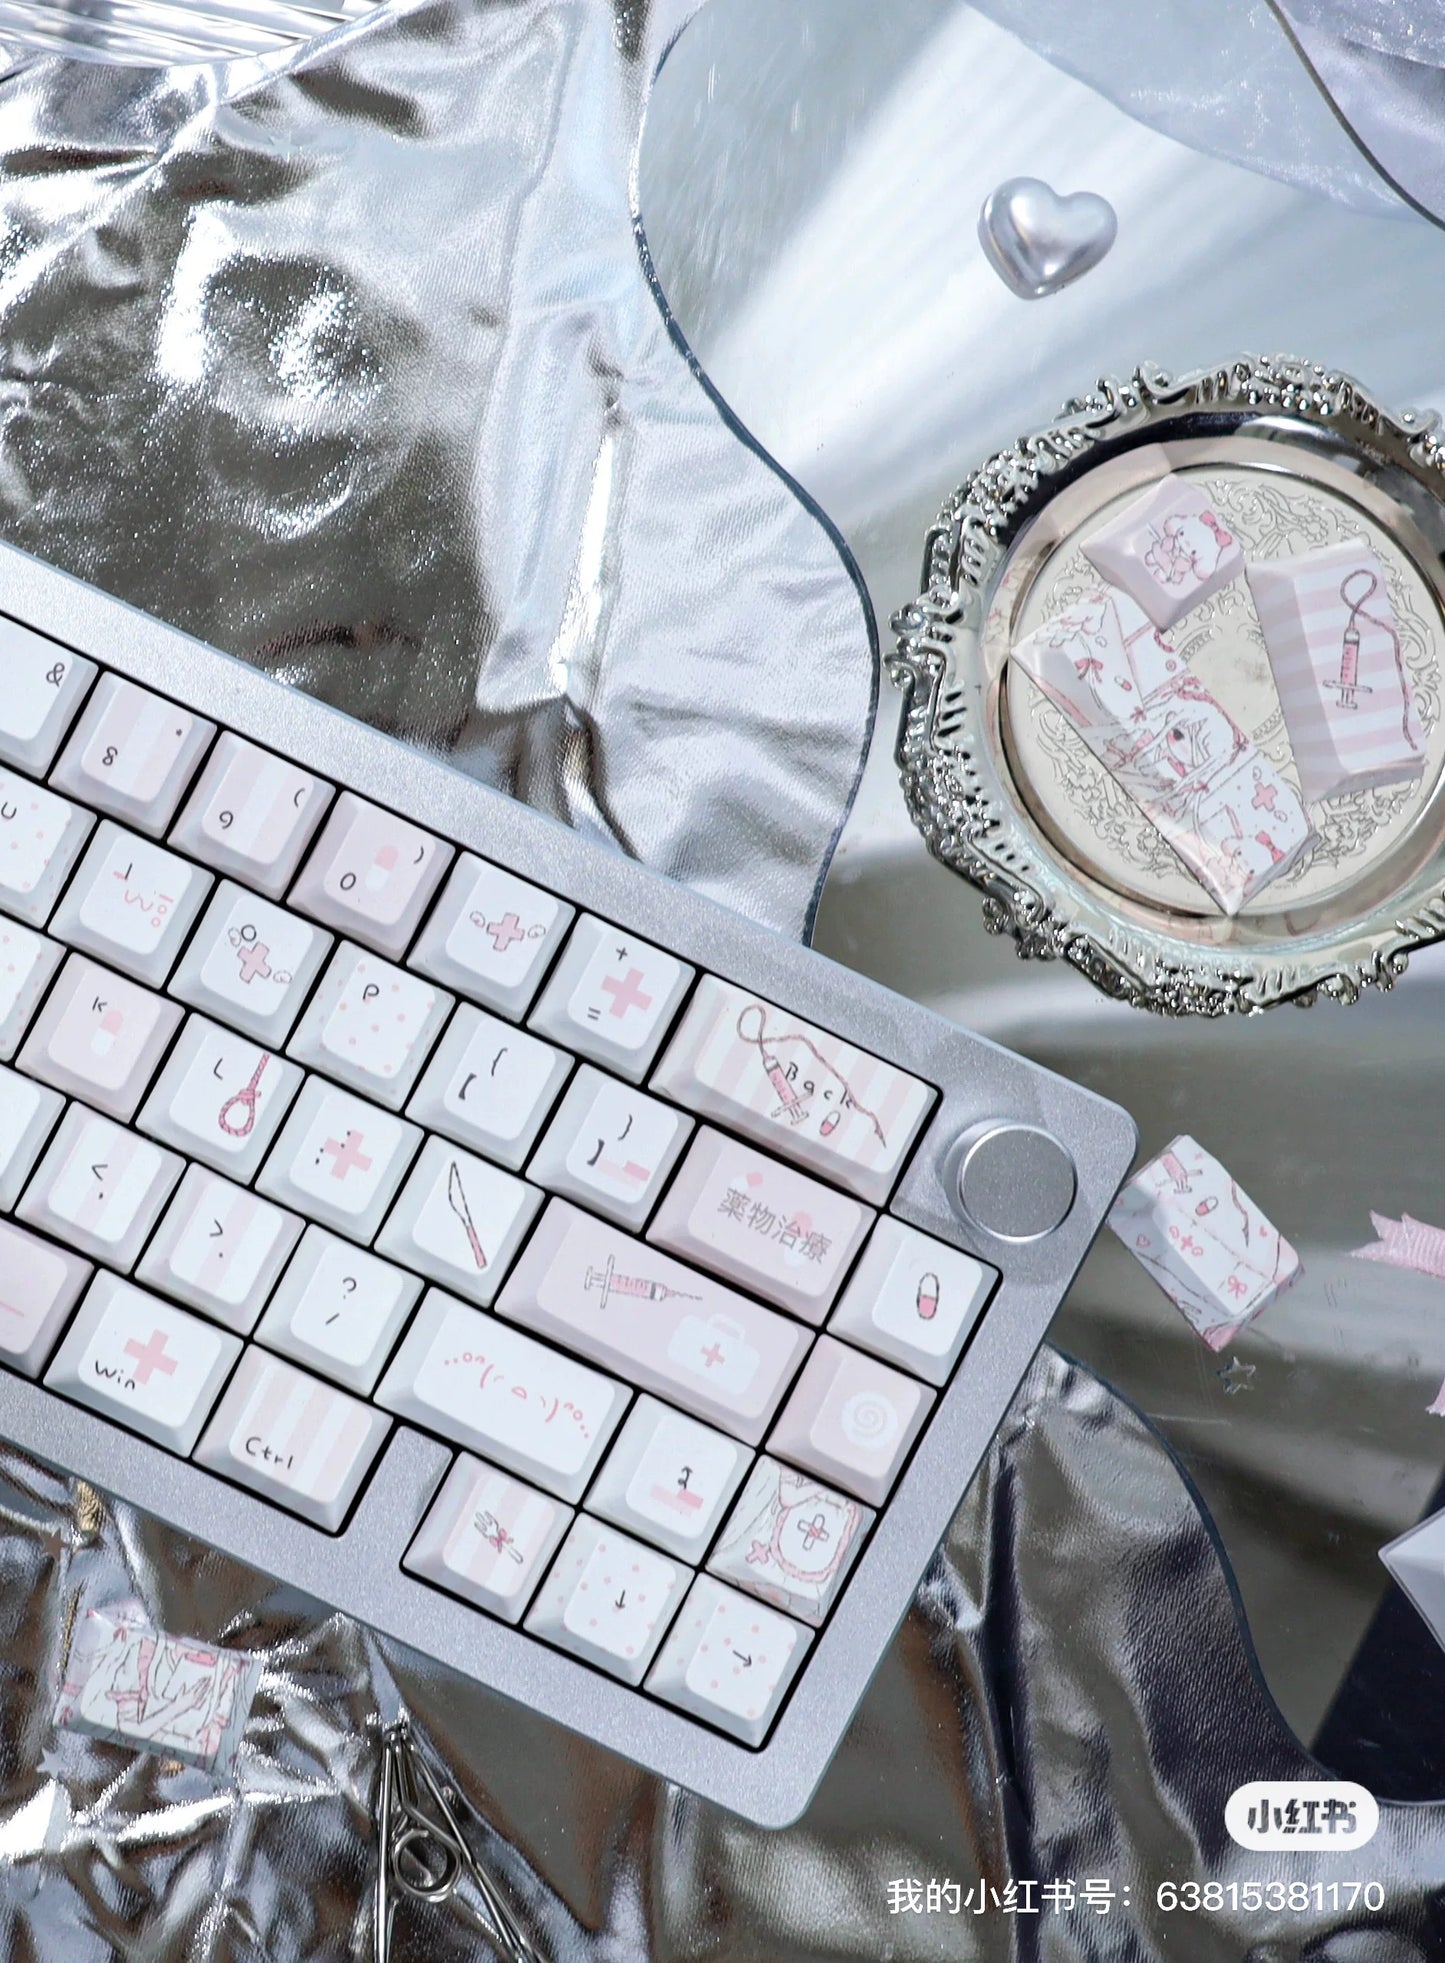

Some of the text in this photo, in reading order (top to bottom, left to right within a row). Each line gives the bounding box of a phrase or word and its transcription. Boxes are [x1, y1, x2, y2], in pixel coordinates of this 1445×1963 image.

[45, 662, 66, 687] &
[101, 746, 119, 767] 8
[362, 983, 380, 1000] P
[92, 996, 108, 1013] K
[213, 1057, 224, 1081] L
[94, 1360, 136, 1391] Win
[245, 1436, 294, 1470] Ctrl
